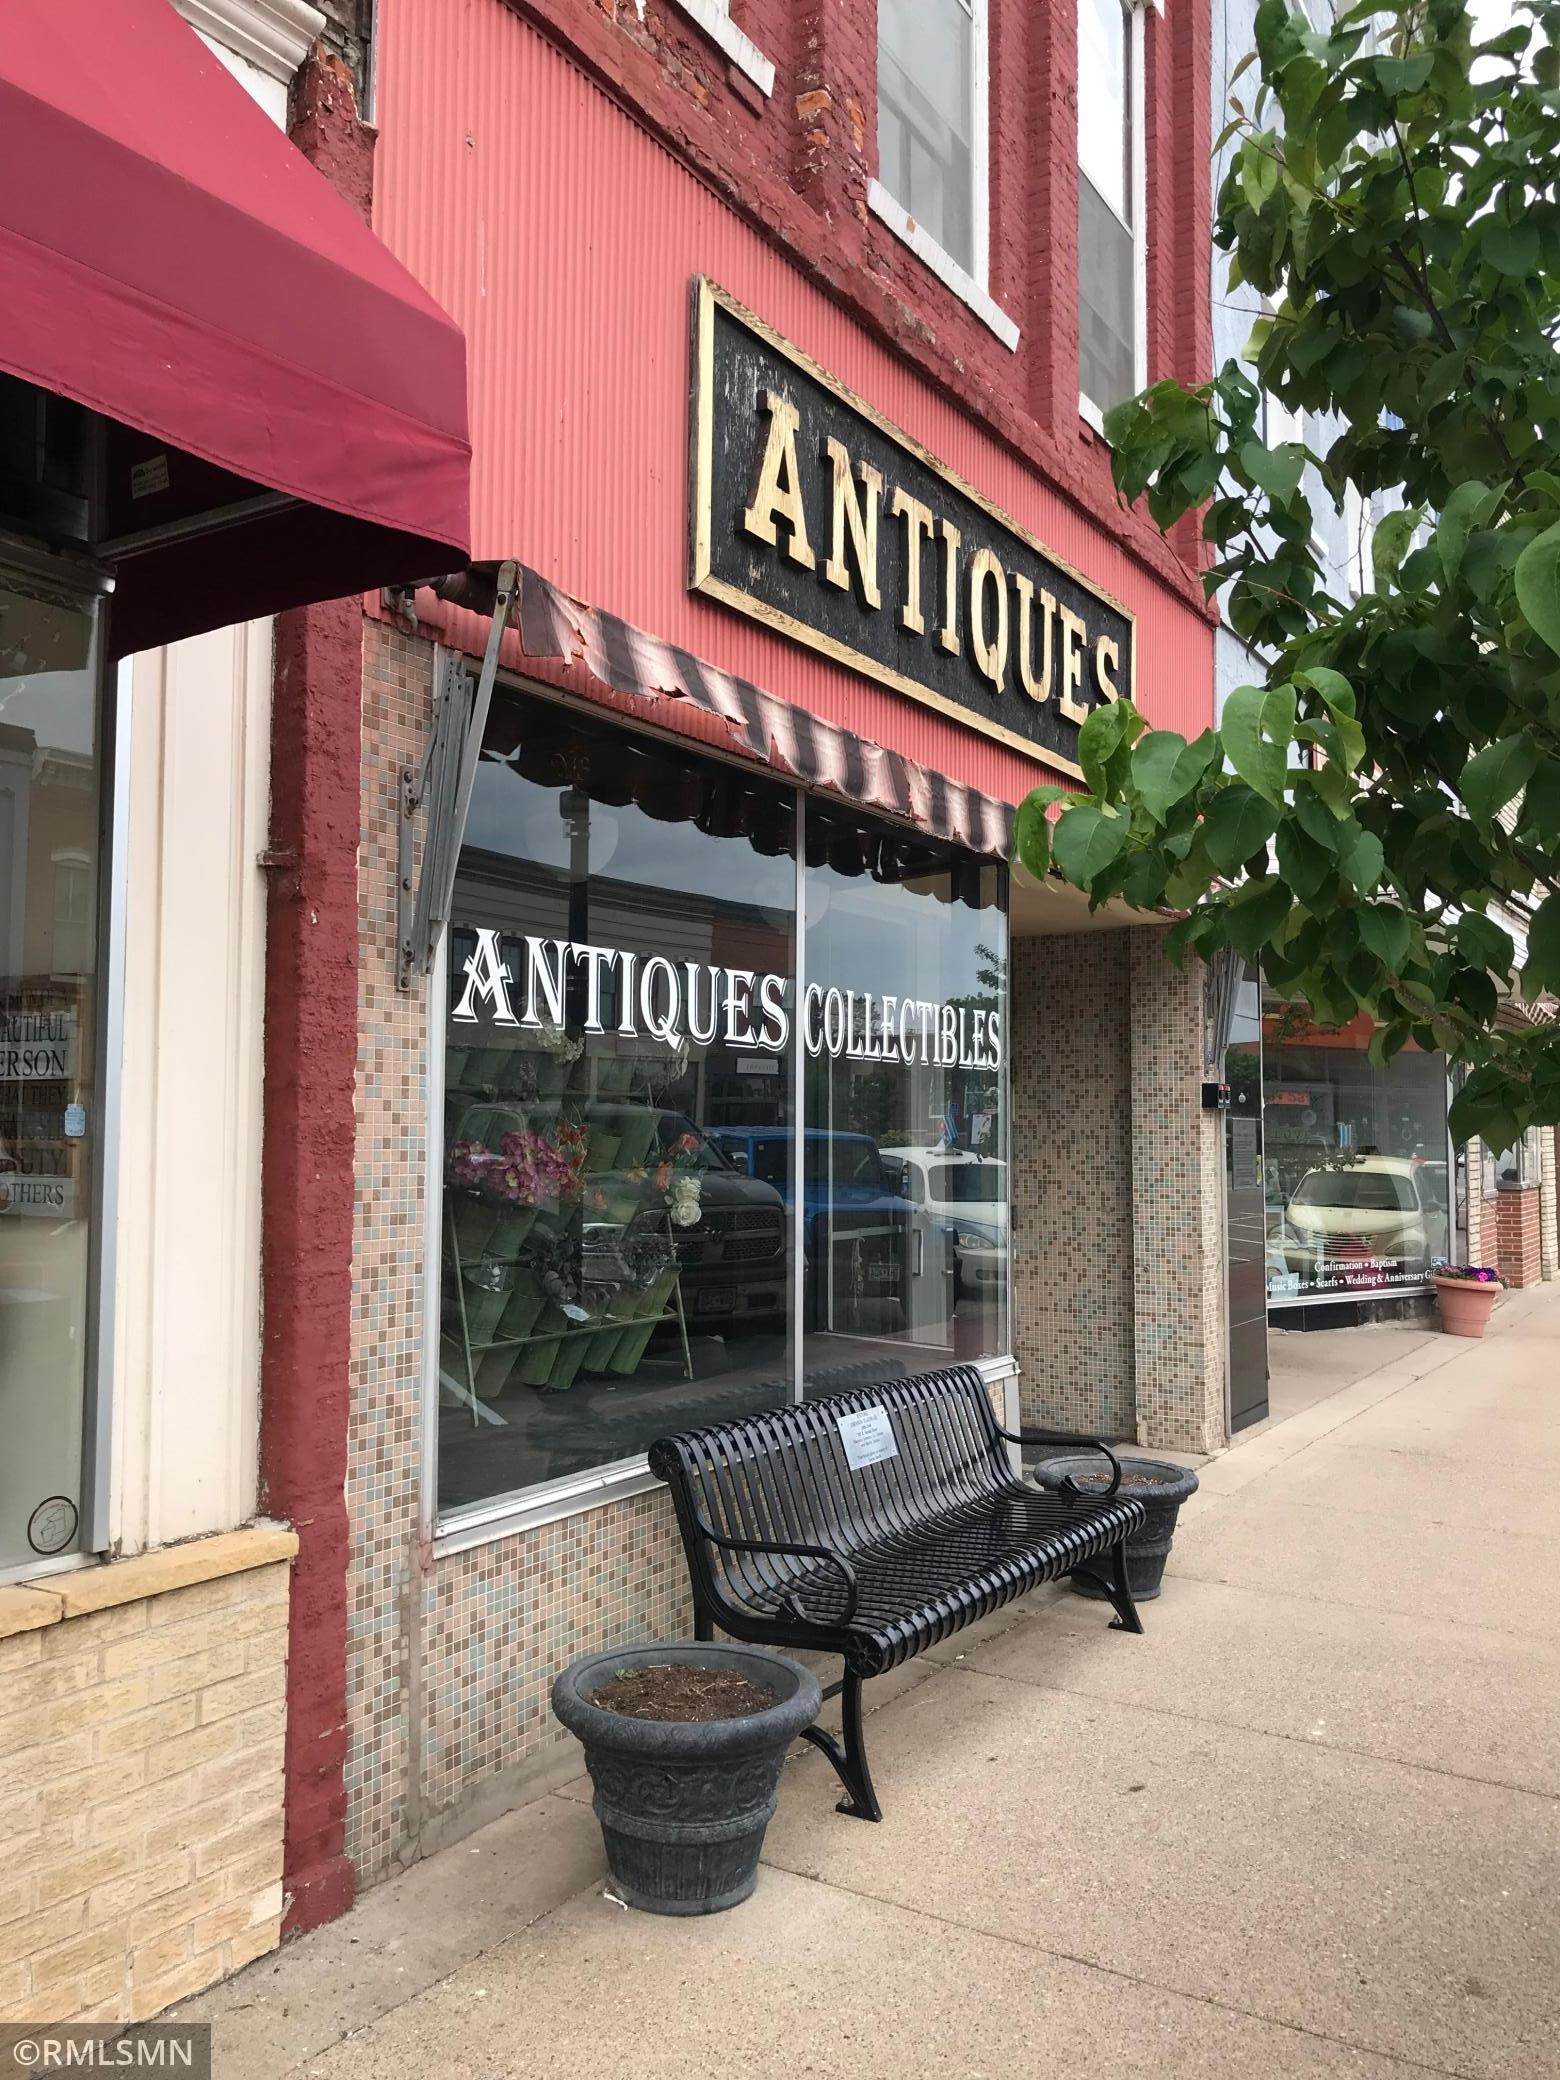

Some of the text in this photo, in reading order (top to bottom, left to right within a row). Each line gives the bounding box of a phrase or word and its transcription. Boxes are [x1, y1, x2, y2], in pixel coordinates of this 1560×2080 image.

[736, 389, 1122, 726] ANTIQUES
[452, 927, 1003, 1073] ANTIQUES COLLECTIBLES
[1314, 1258, 1398, 1273] Confirmation Baptism
[1316, 1275, 1339, 1289] Scarfs
[1345, 1273, 1377, 1287] Wedding
[1384, 1272, 1424, 1283] Anniversary
